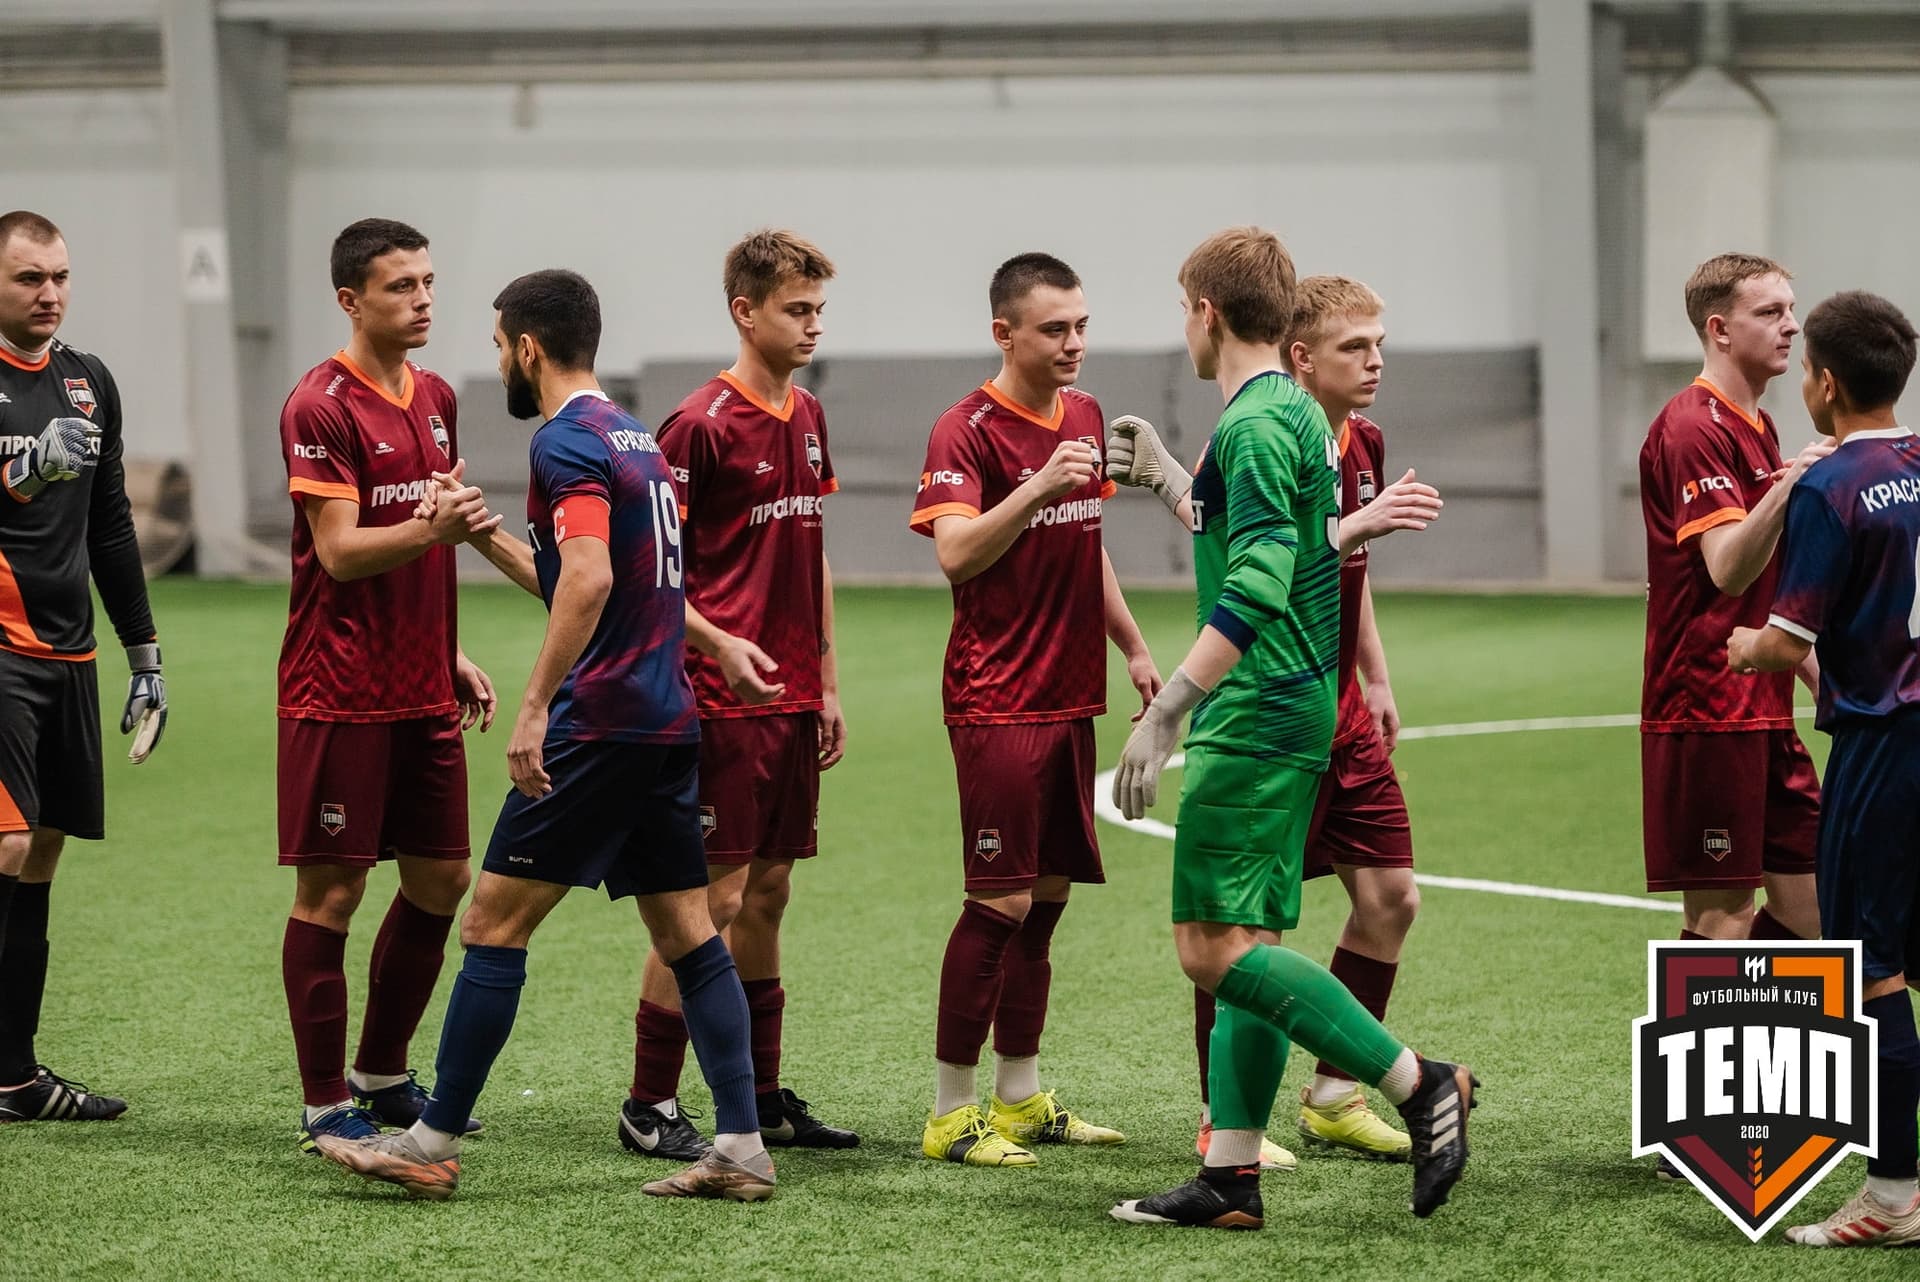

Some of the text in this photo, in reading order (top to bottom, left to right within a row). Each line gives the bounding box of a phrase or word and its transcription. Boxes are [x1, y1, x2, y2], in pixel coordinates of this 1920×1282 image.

[294, 443, 327, 459] ПСБ
[932, 470, 964, 486] ПСБ
[649, 480, 682, 588] 19
